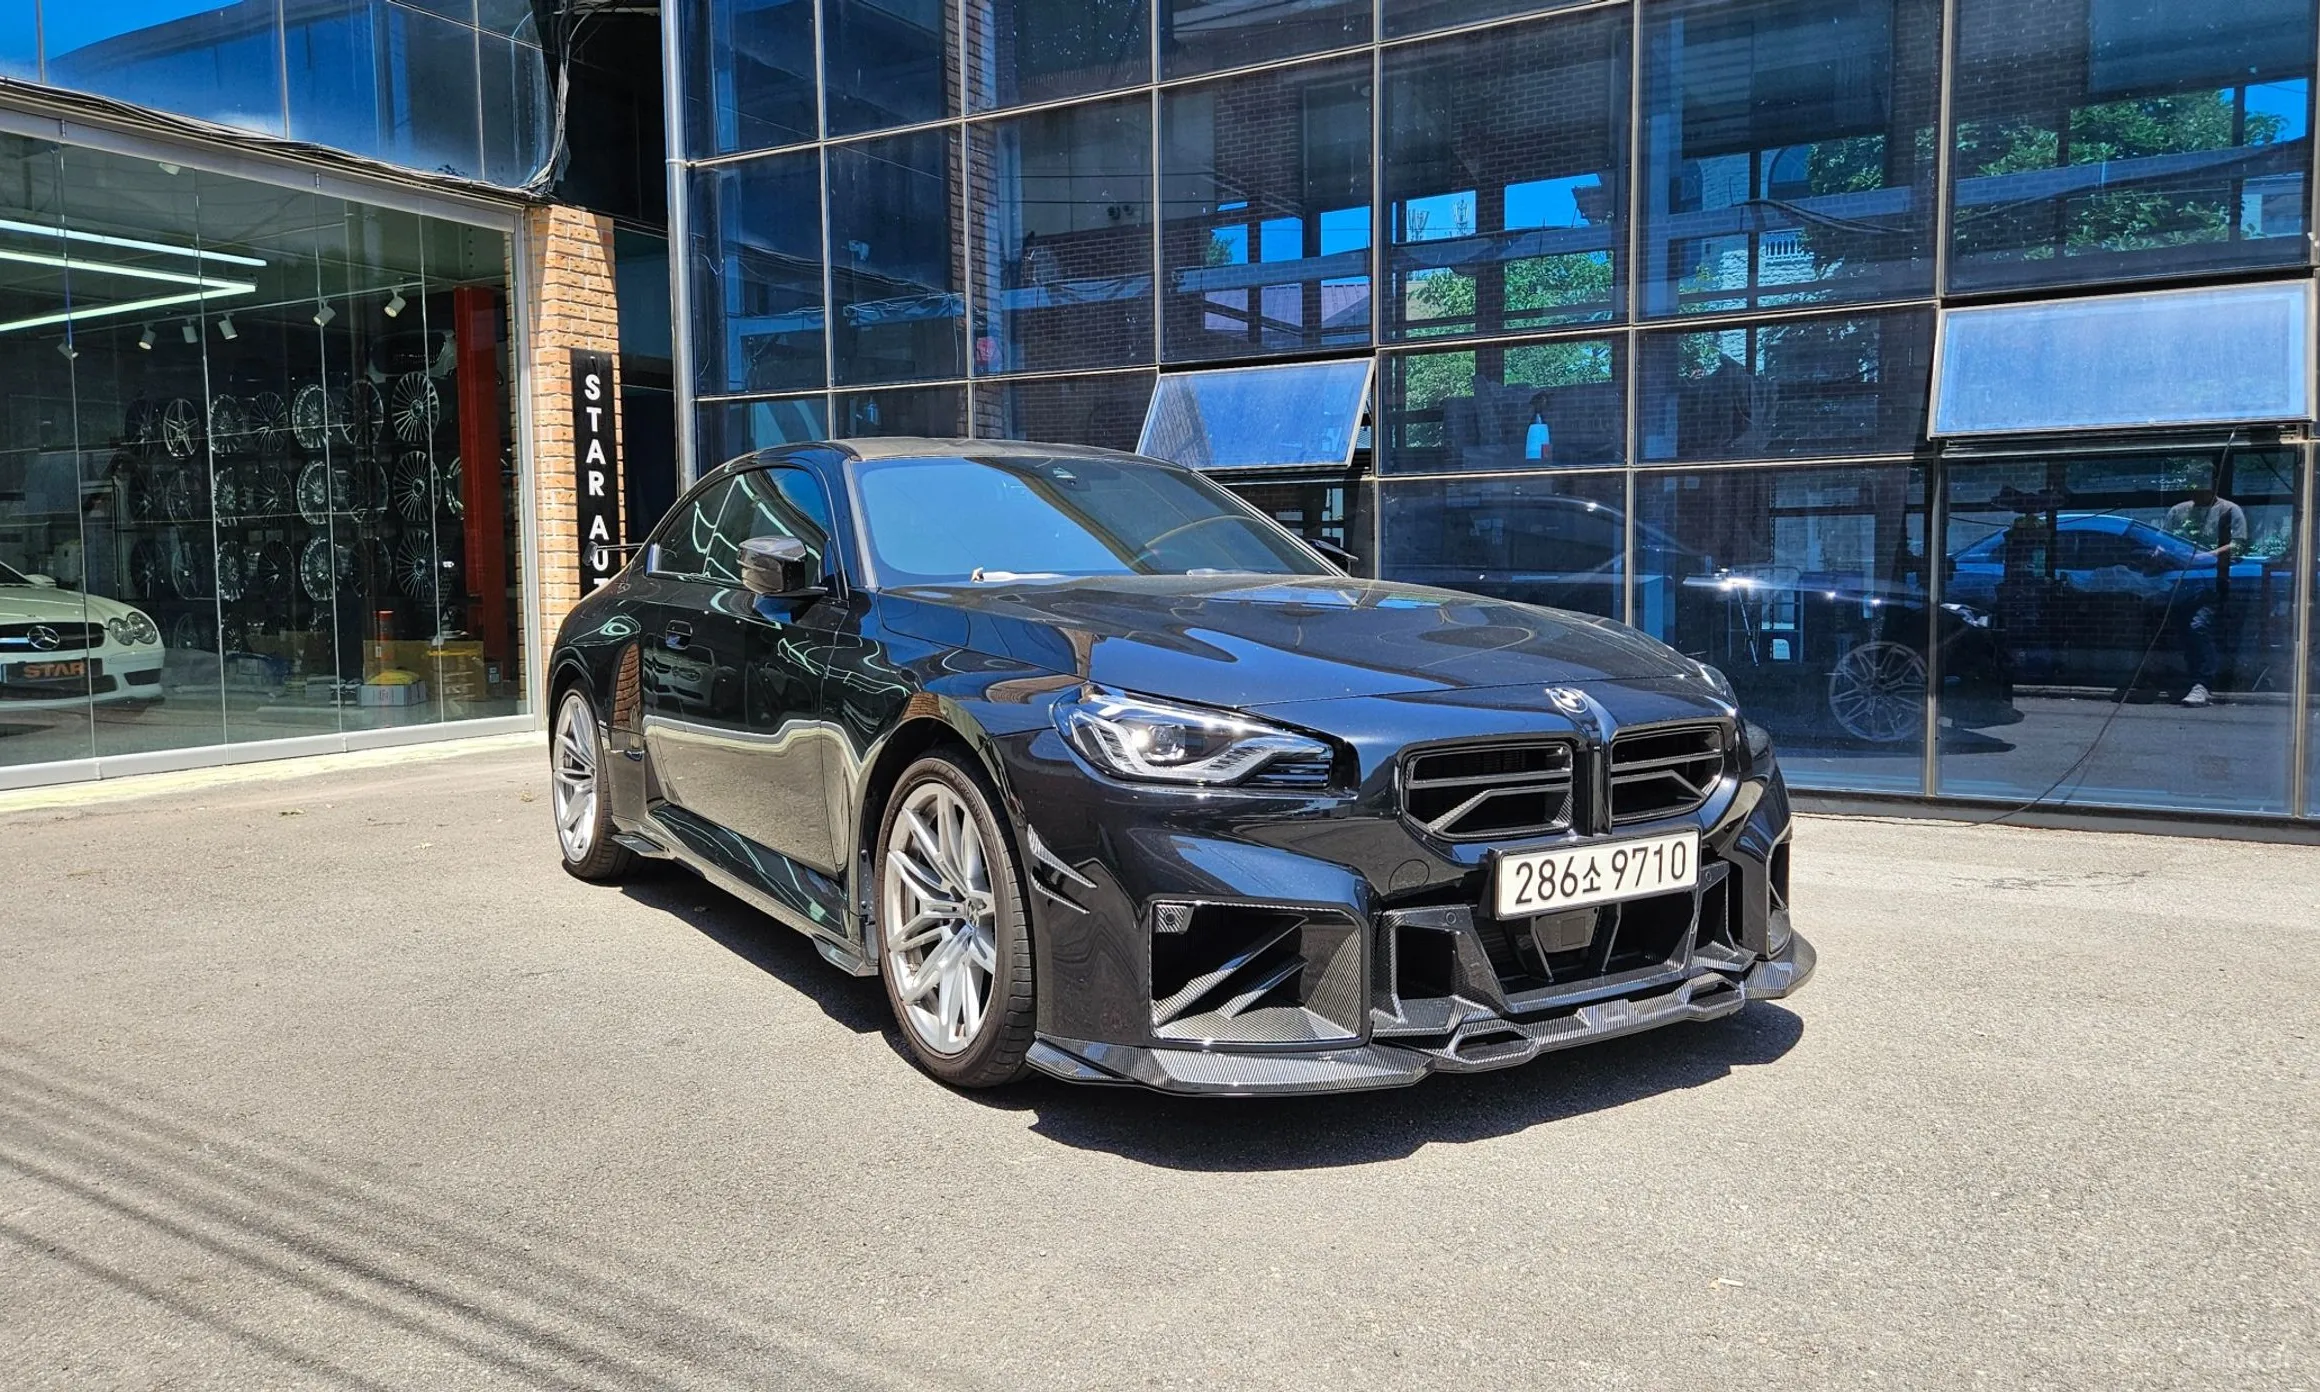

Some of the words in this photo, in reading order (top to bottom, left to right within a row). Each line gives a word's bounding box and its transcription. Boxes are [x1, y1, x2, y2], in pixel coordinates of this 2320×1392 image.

[584, 374, 607, 496] STAR
[23, 662, 85, 677] STAR
[1515, 856, 1601, 905] 286소
[1611, 841, 1686, 890] 9710
